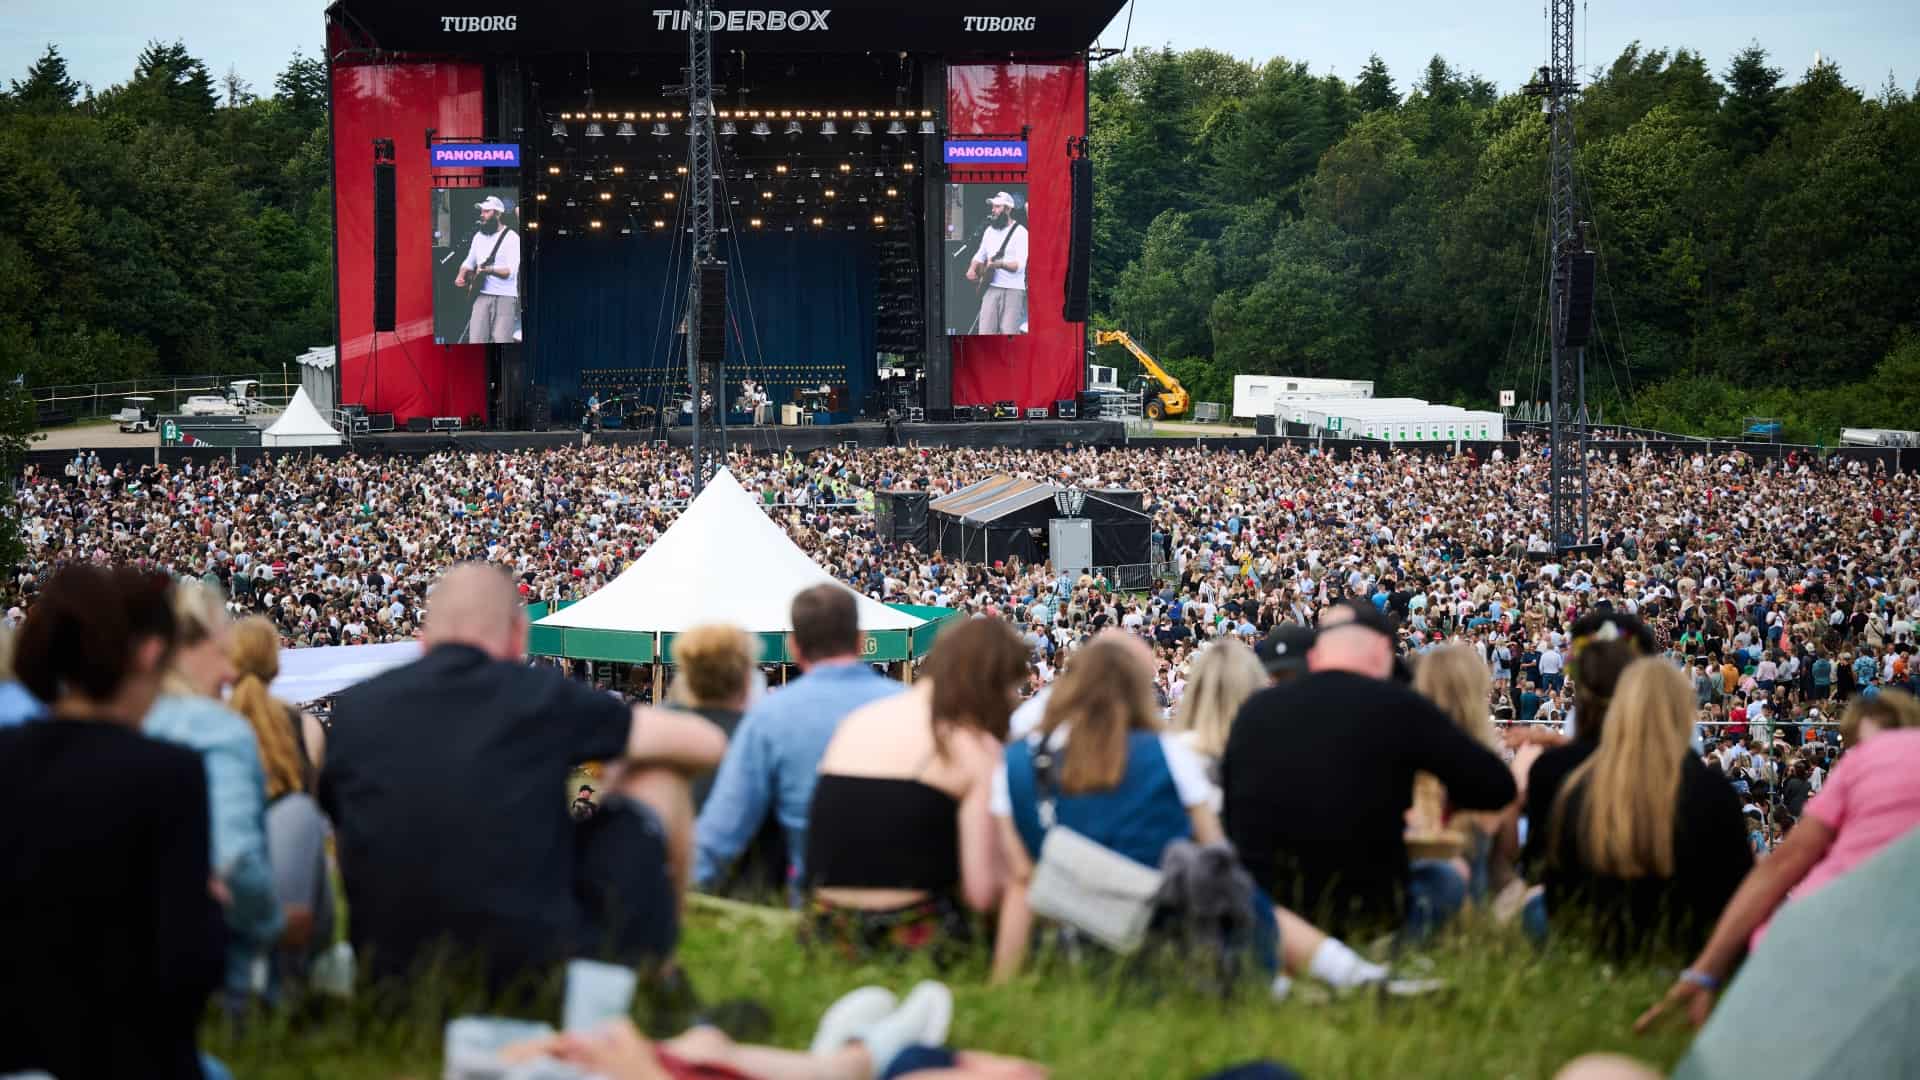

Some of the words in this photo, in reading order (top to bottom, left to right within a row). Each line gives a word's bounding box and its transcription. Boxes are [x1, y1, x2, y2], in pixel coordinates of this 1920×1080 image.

[440, 15, 517, 32] TUBORG
[652, 9, 832, 32] TINDERBOX
[963, 15, 1037, 32] TUBORG
[435, 149, 515, 161] PANORAMA
[948, 146, 1023, 157] PANORAMA
